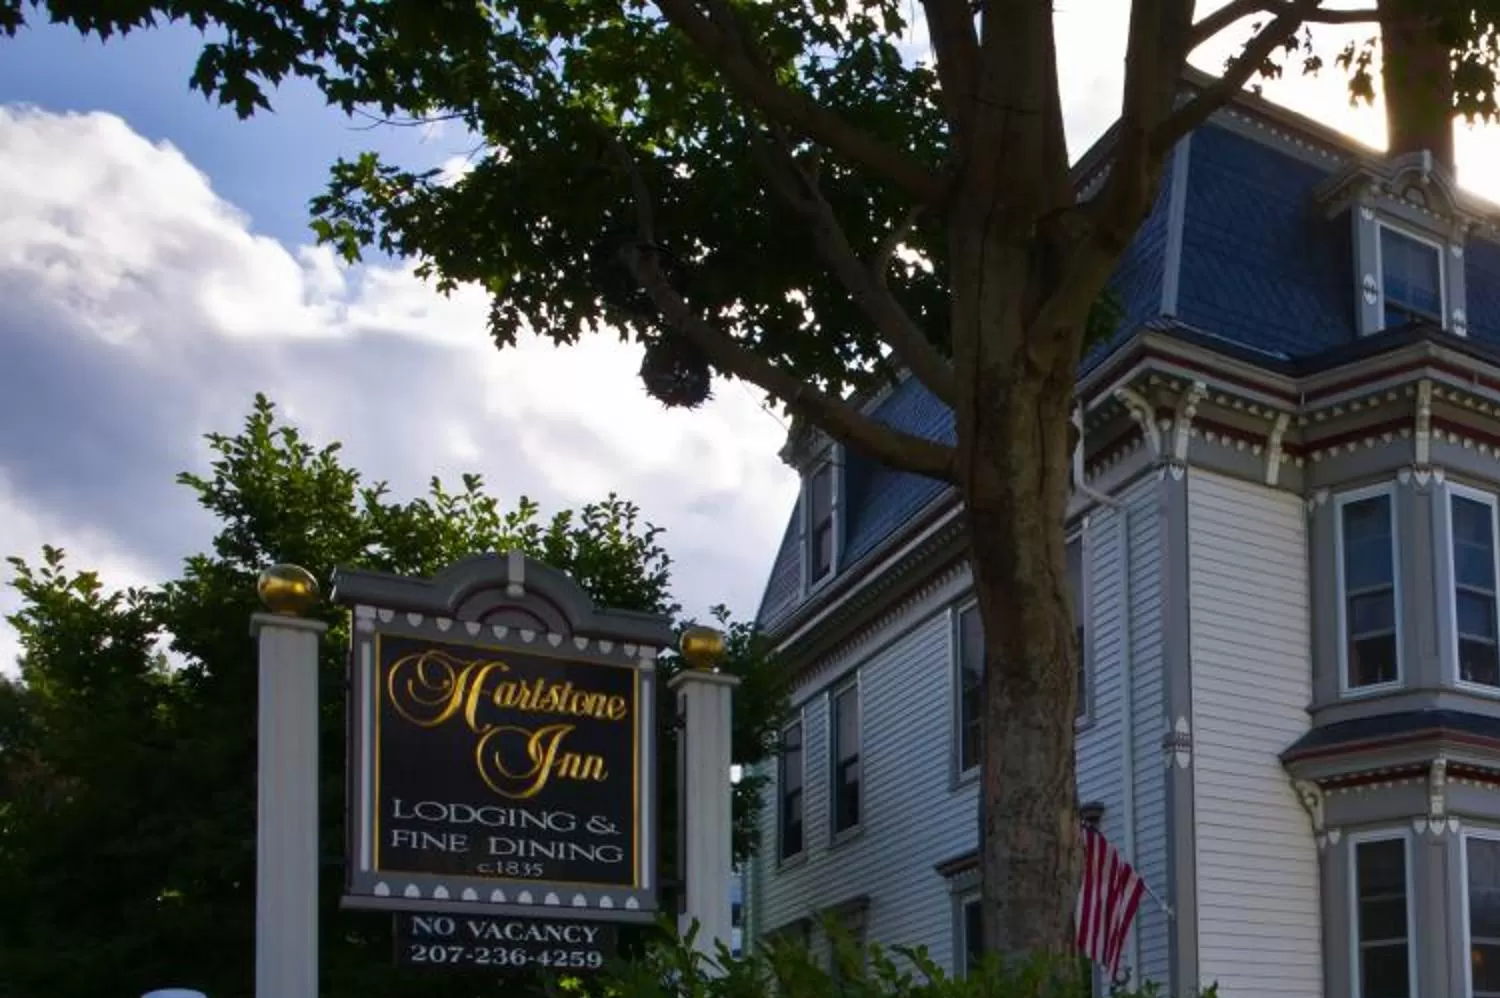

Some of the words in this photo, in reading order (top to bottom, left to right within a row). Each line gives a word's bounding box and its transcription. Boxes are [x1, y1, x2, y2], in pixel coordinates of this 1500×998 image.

[388, 650, 627, 733] Hartstone
[477, 725, 608, 798] Inn
[393, 799, 576, 832] LODGING
[586, 815, 622, 834] &
[392, 830, 468, 852] FINE
[489, 837, 624, 863] DINING
[476, 860, 544, 877] c.1835
[411, 916, 455, 936] NO
[467, 921, 599, 943] VACANCY
[411, 945, 603, 968] 207-236-4259
